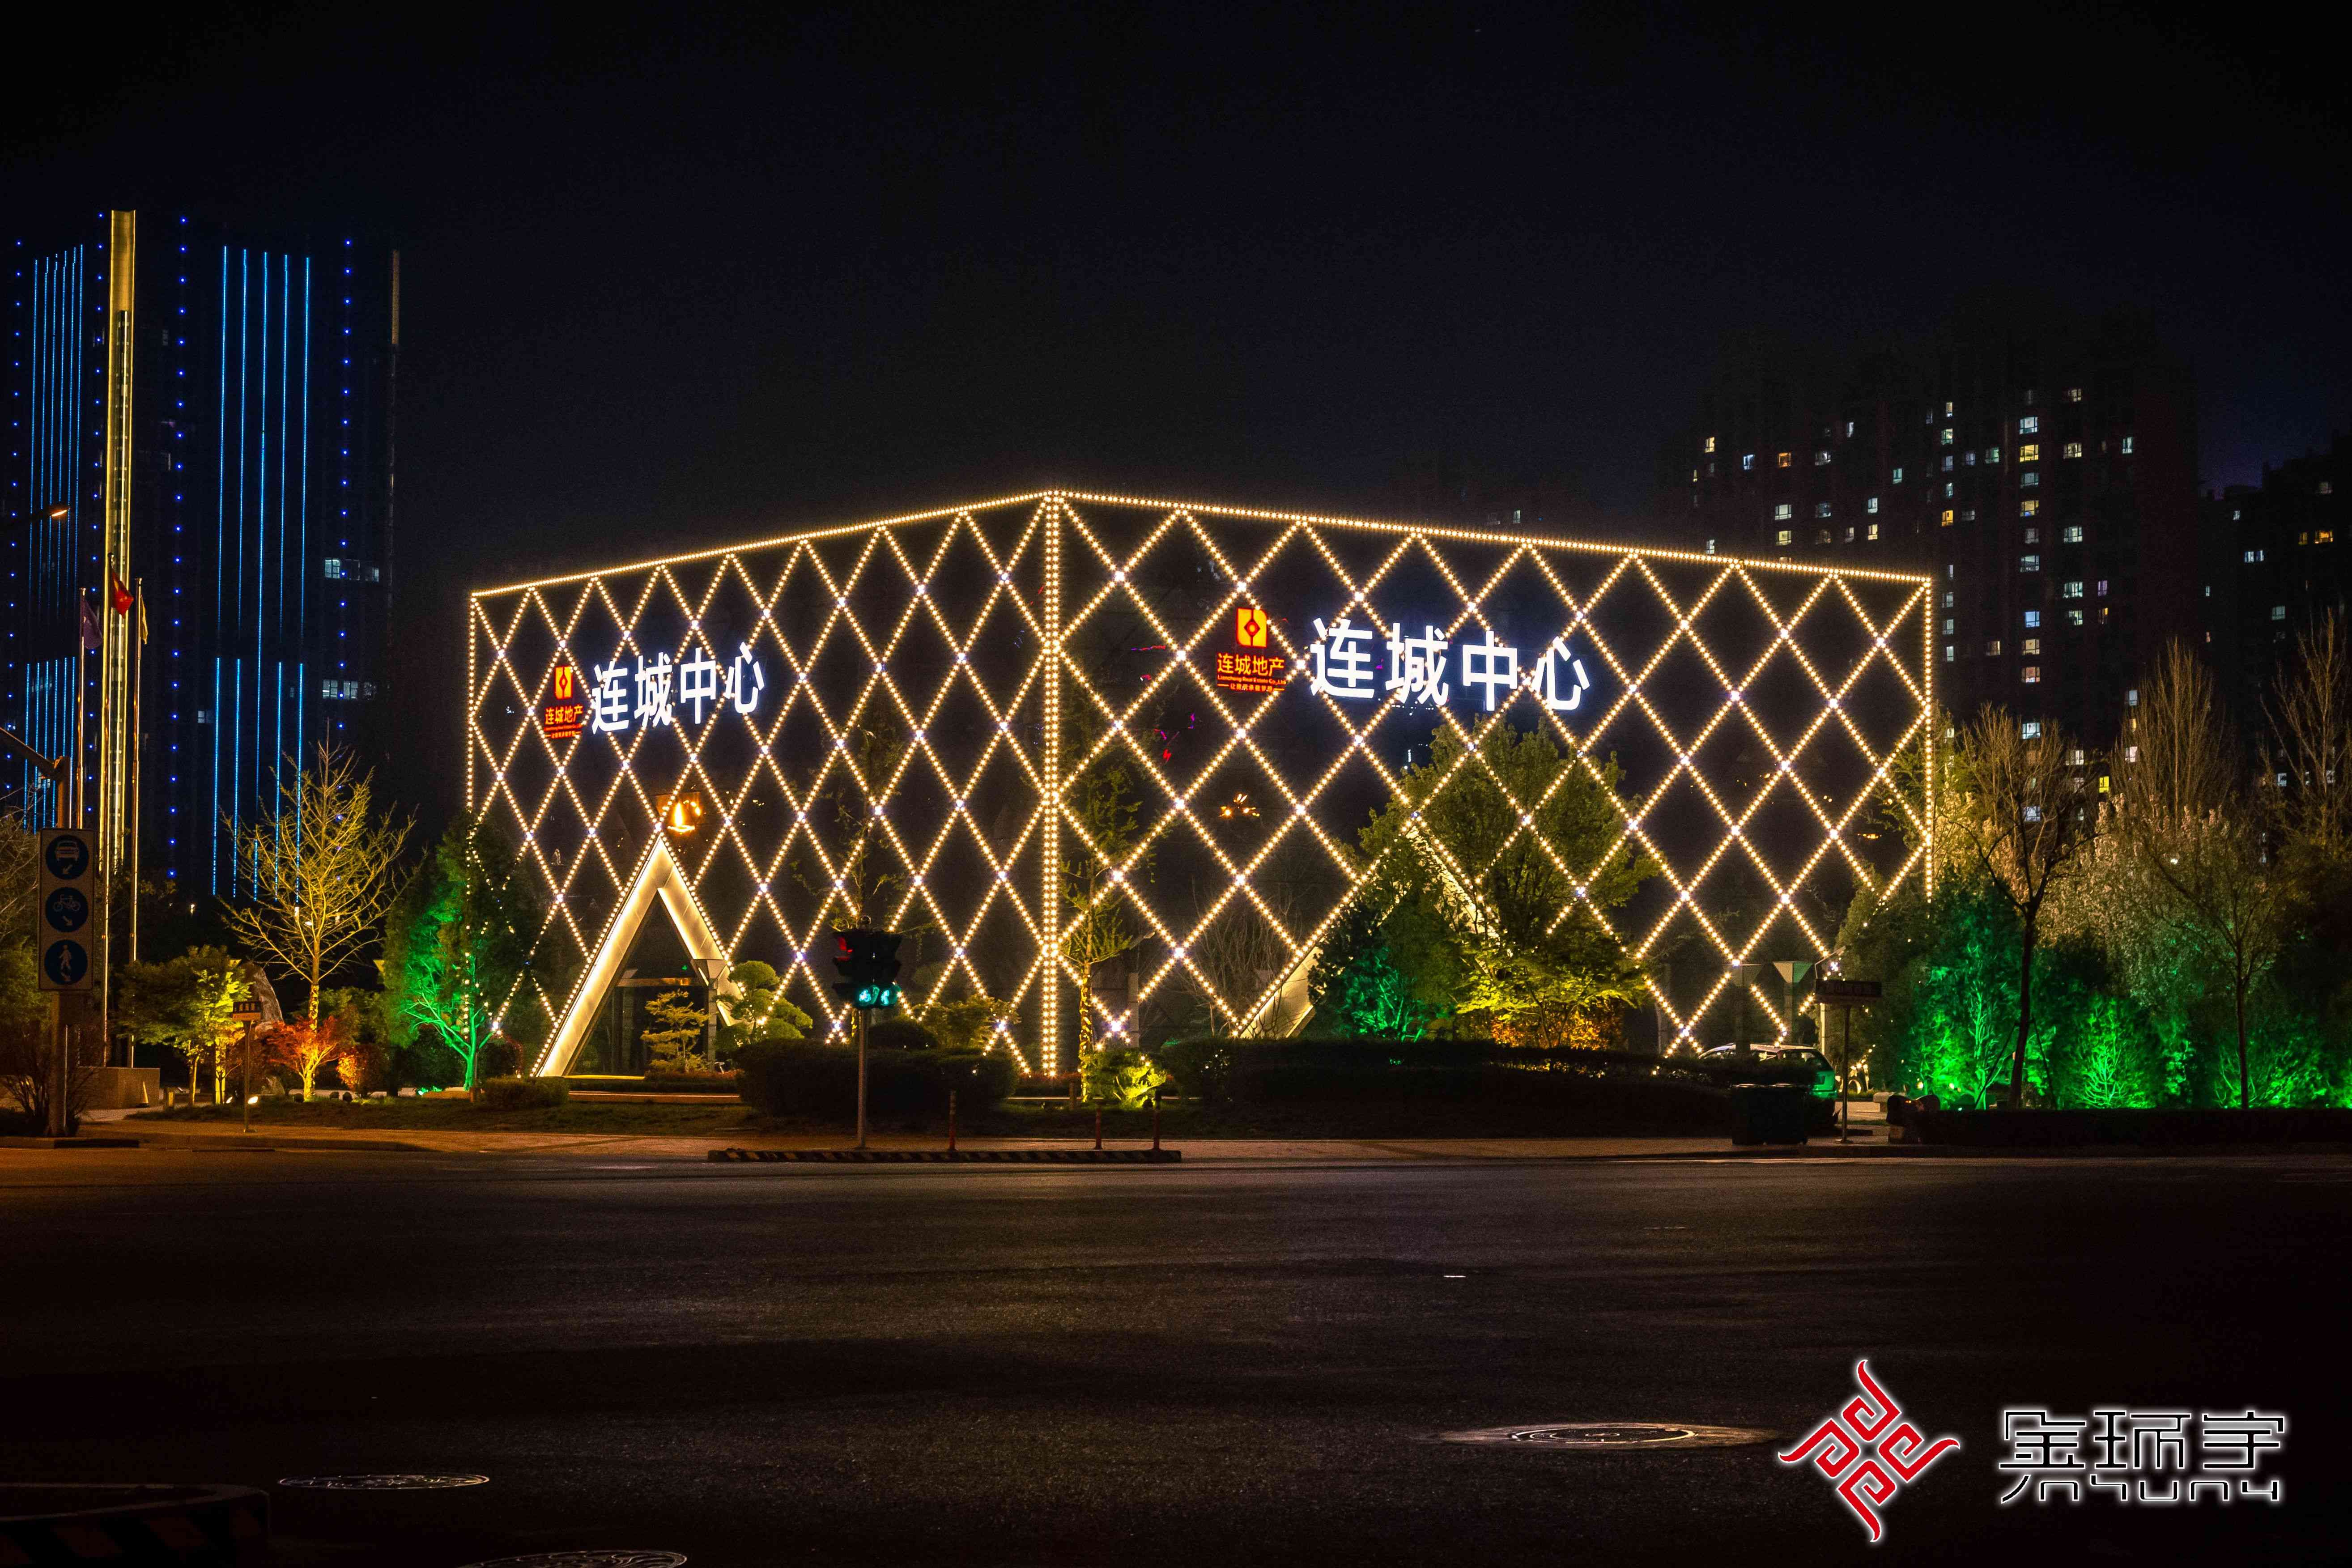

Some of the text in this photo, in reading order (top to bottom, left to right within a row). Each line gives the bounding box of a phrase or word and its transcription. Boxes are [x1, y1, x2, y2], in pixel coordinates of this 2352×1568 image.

[591, 642, 765, 735] 连城中心
[1217, 653, 1285, 677] 连城地产
[1310, 617, 1590, 712] 连城中心
[545, 704, 583, 725] 连城地产
